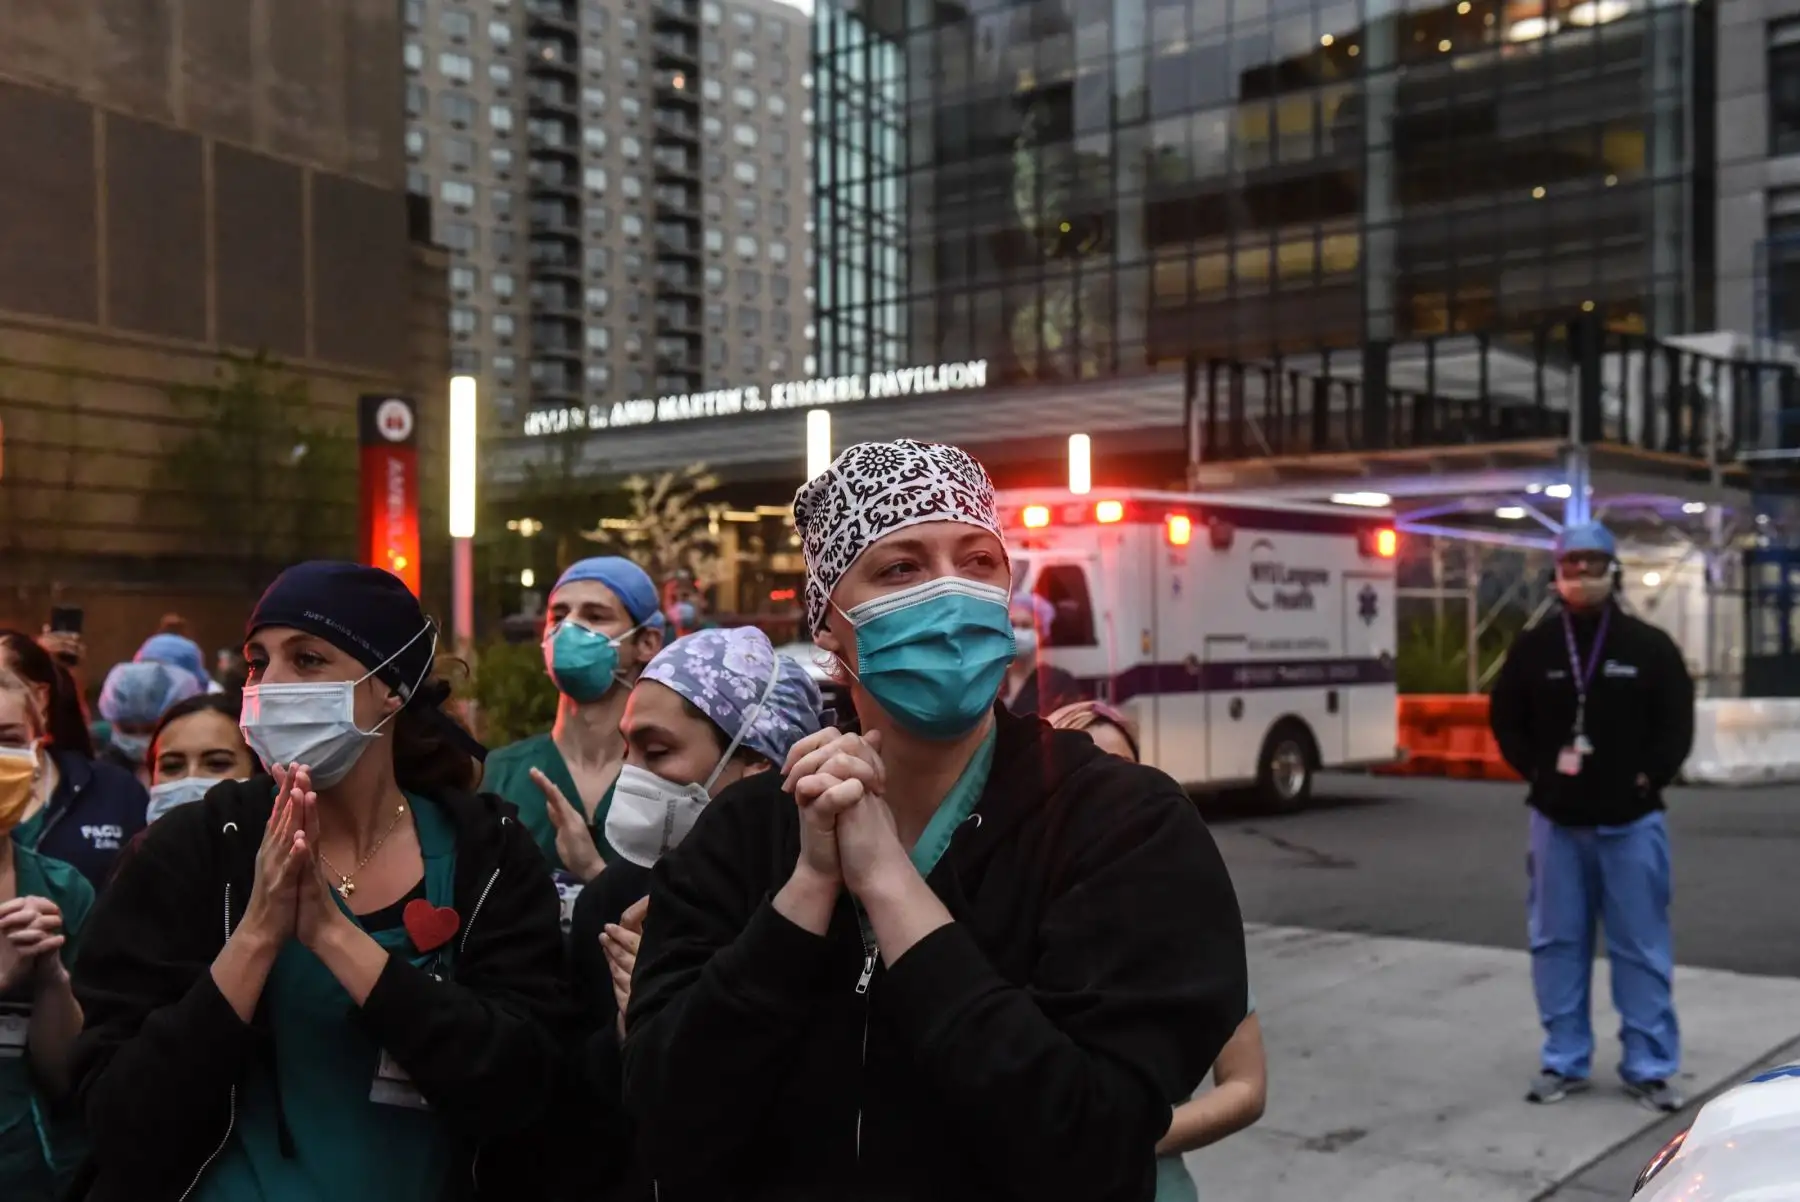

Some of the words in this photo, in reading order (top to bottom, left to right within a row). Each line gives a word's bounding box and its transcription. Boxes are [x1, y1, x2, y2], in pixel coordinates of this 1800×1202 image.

[610, 399, 655, 427] AND
[657, 387, 742, 421] MARTIN
[743, 386, 767, 412] S.
[770, 374, 866, 410] KIMMEL
[869, 359, 988, 398] PAVILION
[303, 610, 325, 621] JUST
